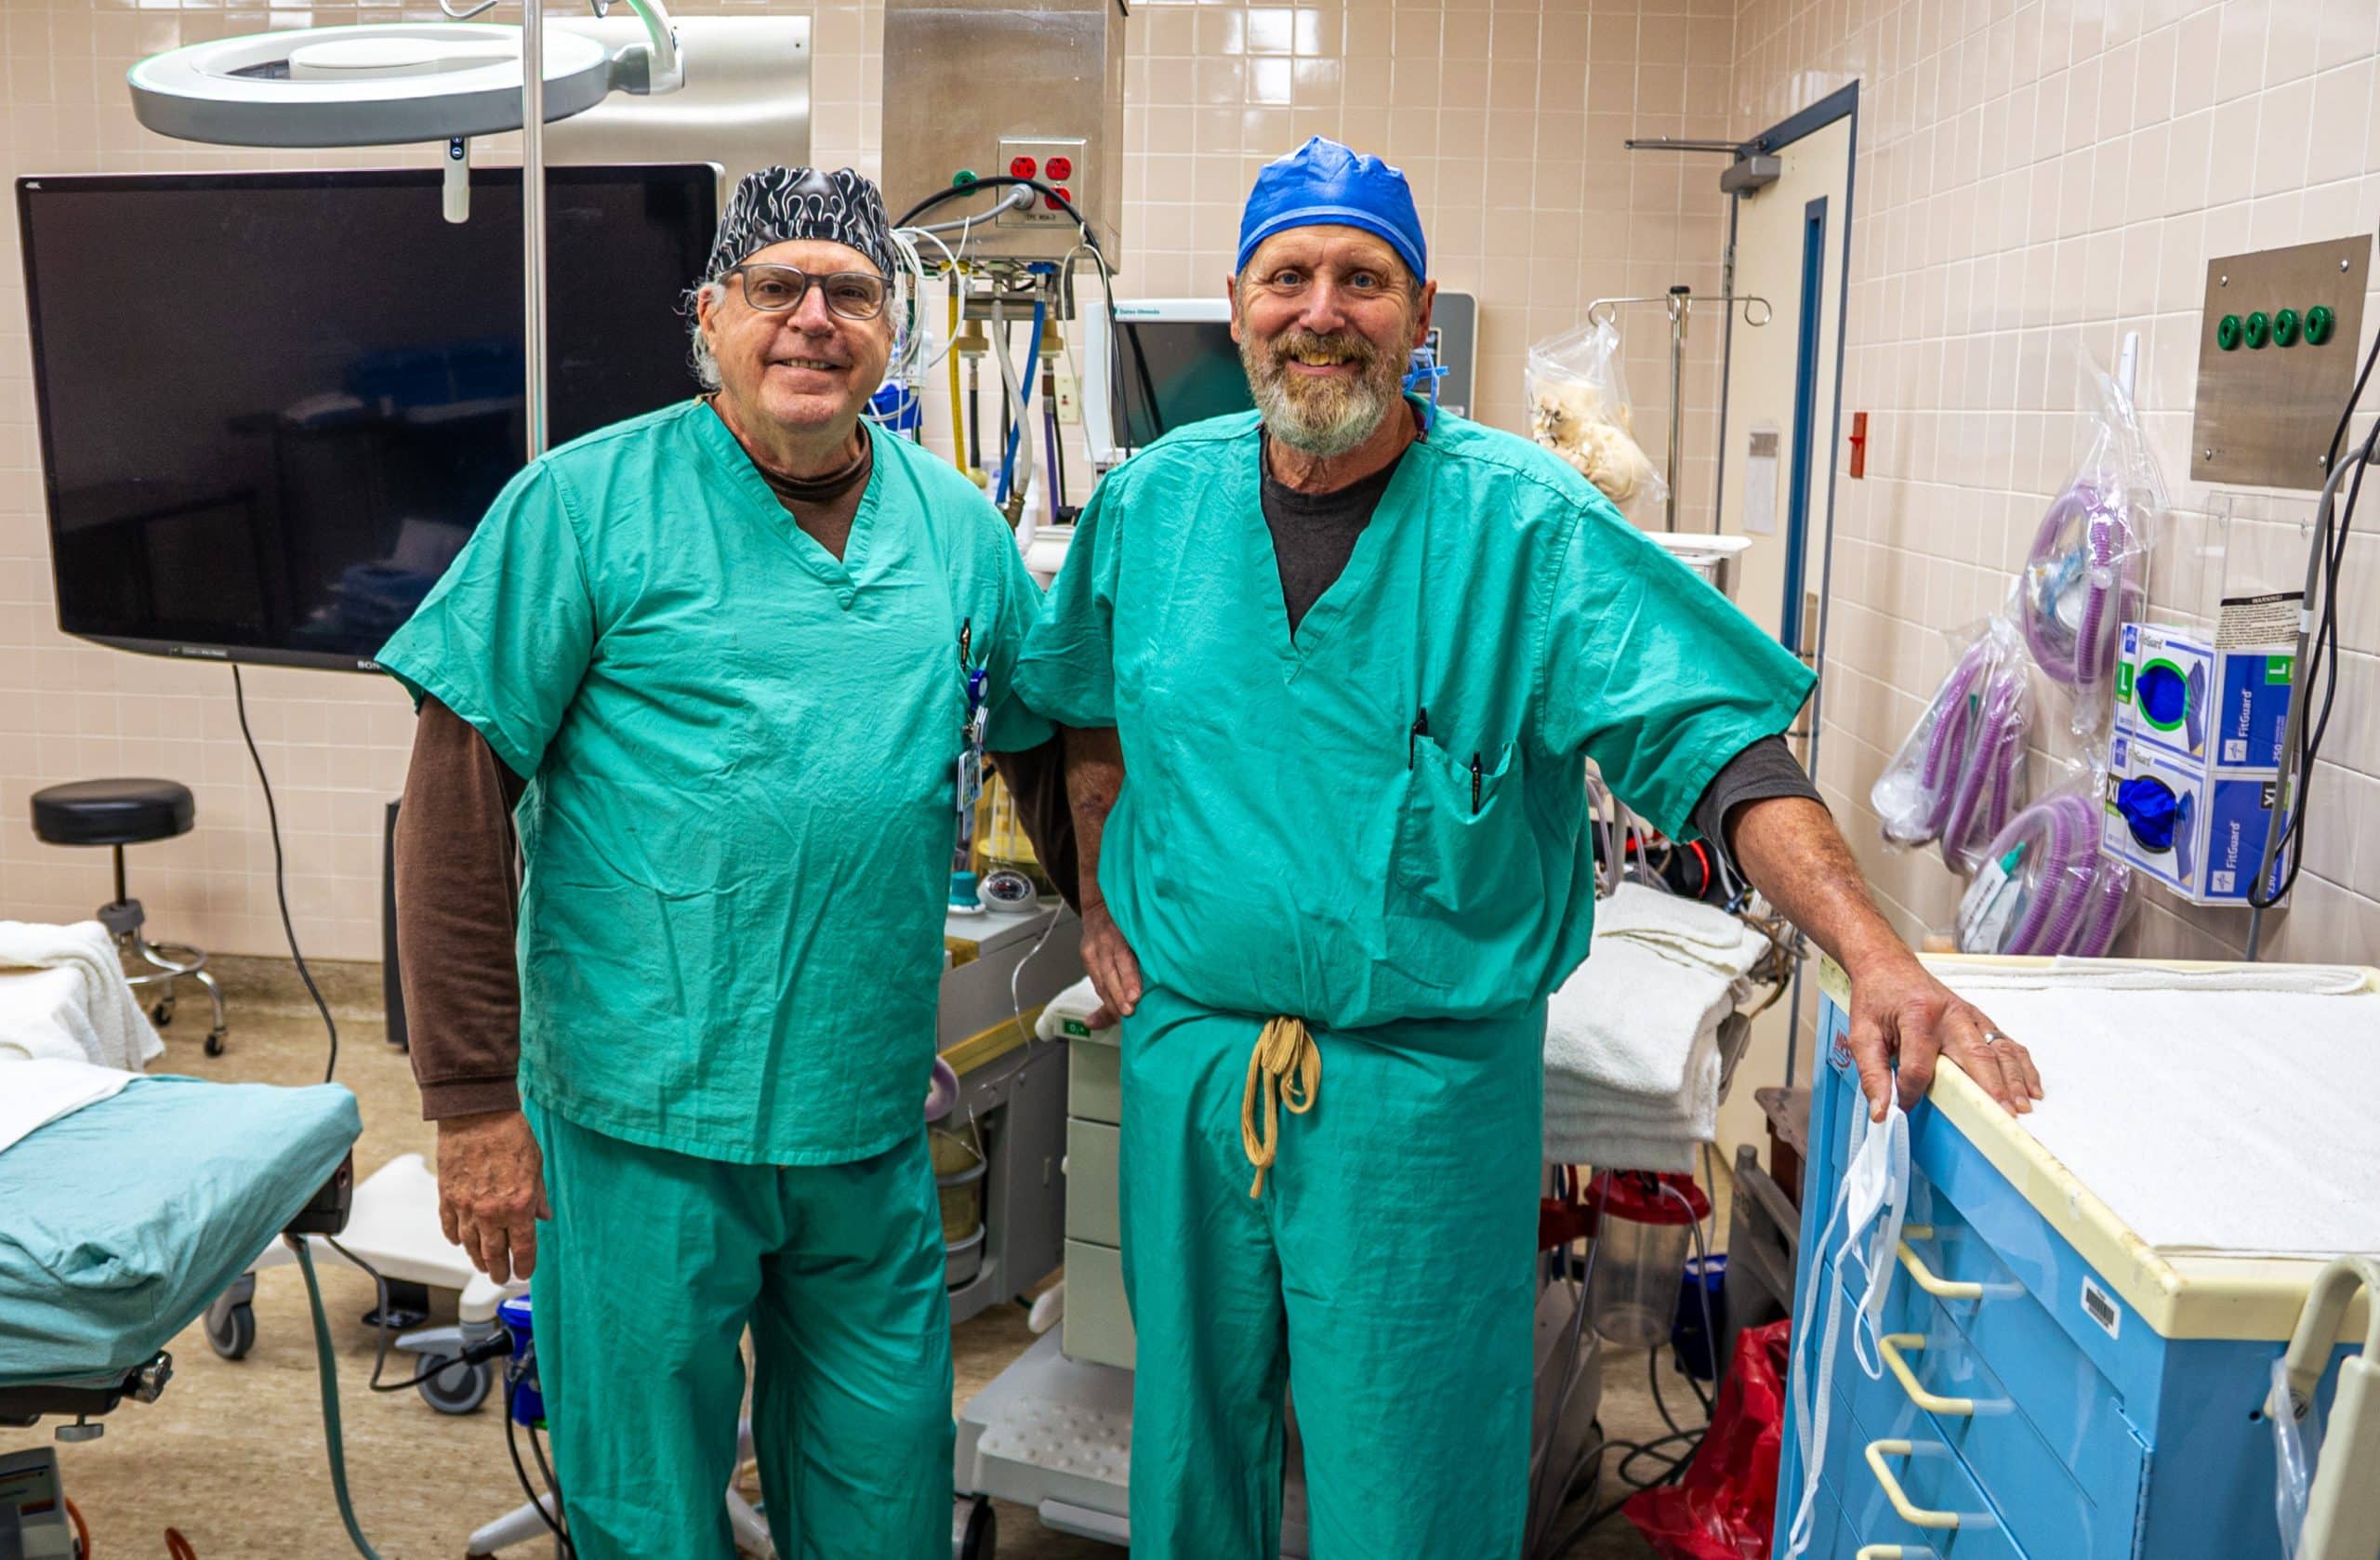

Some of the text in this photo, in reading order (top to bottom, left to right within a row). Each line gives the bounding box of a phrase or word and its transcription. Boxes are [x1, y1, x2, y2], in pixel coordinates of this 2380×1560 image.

[2121, 665, 2128, 691] L
[2268, 663, 2286, 675] L
[2239, 689, 2252, 738] FitGuard
[2226, 822, 2241, 869] FitGuard
